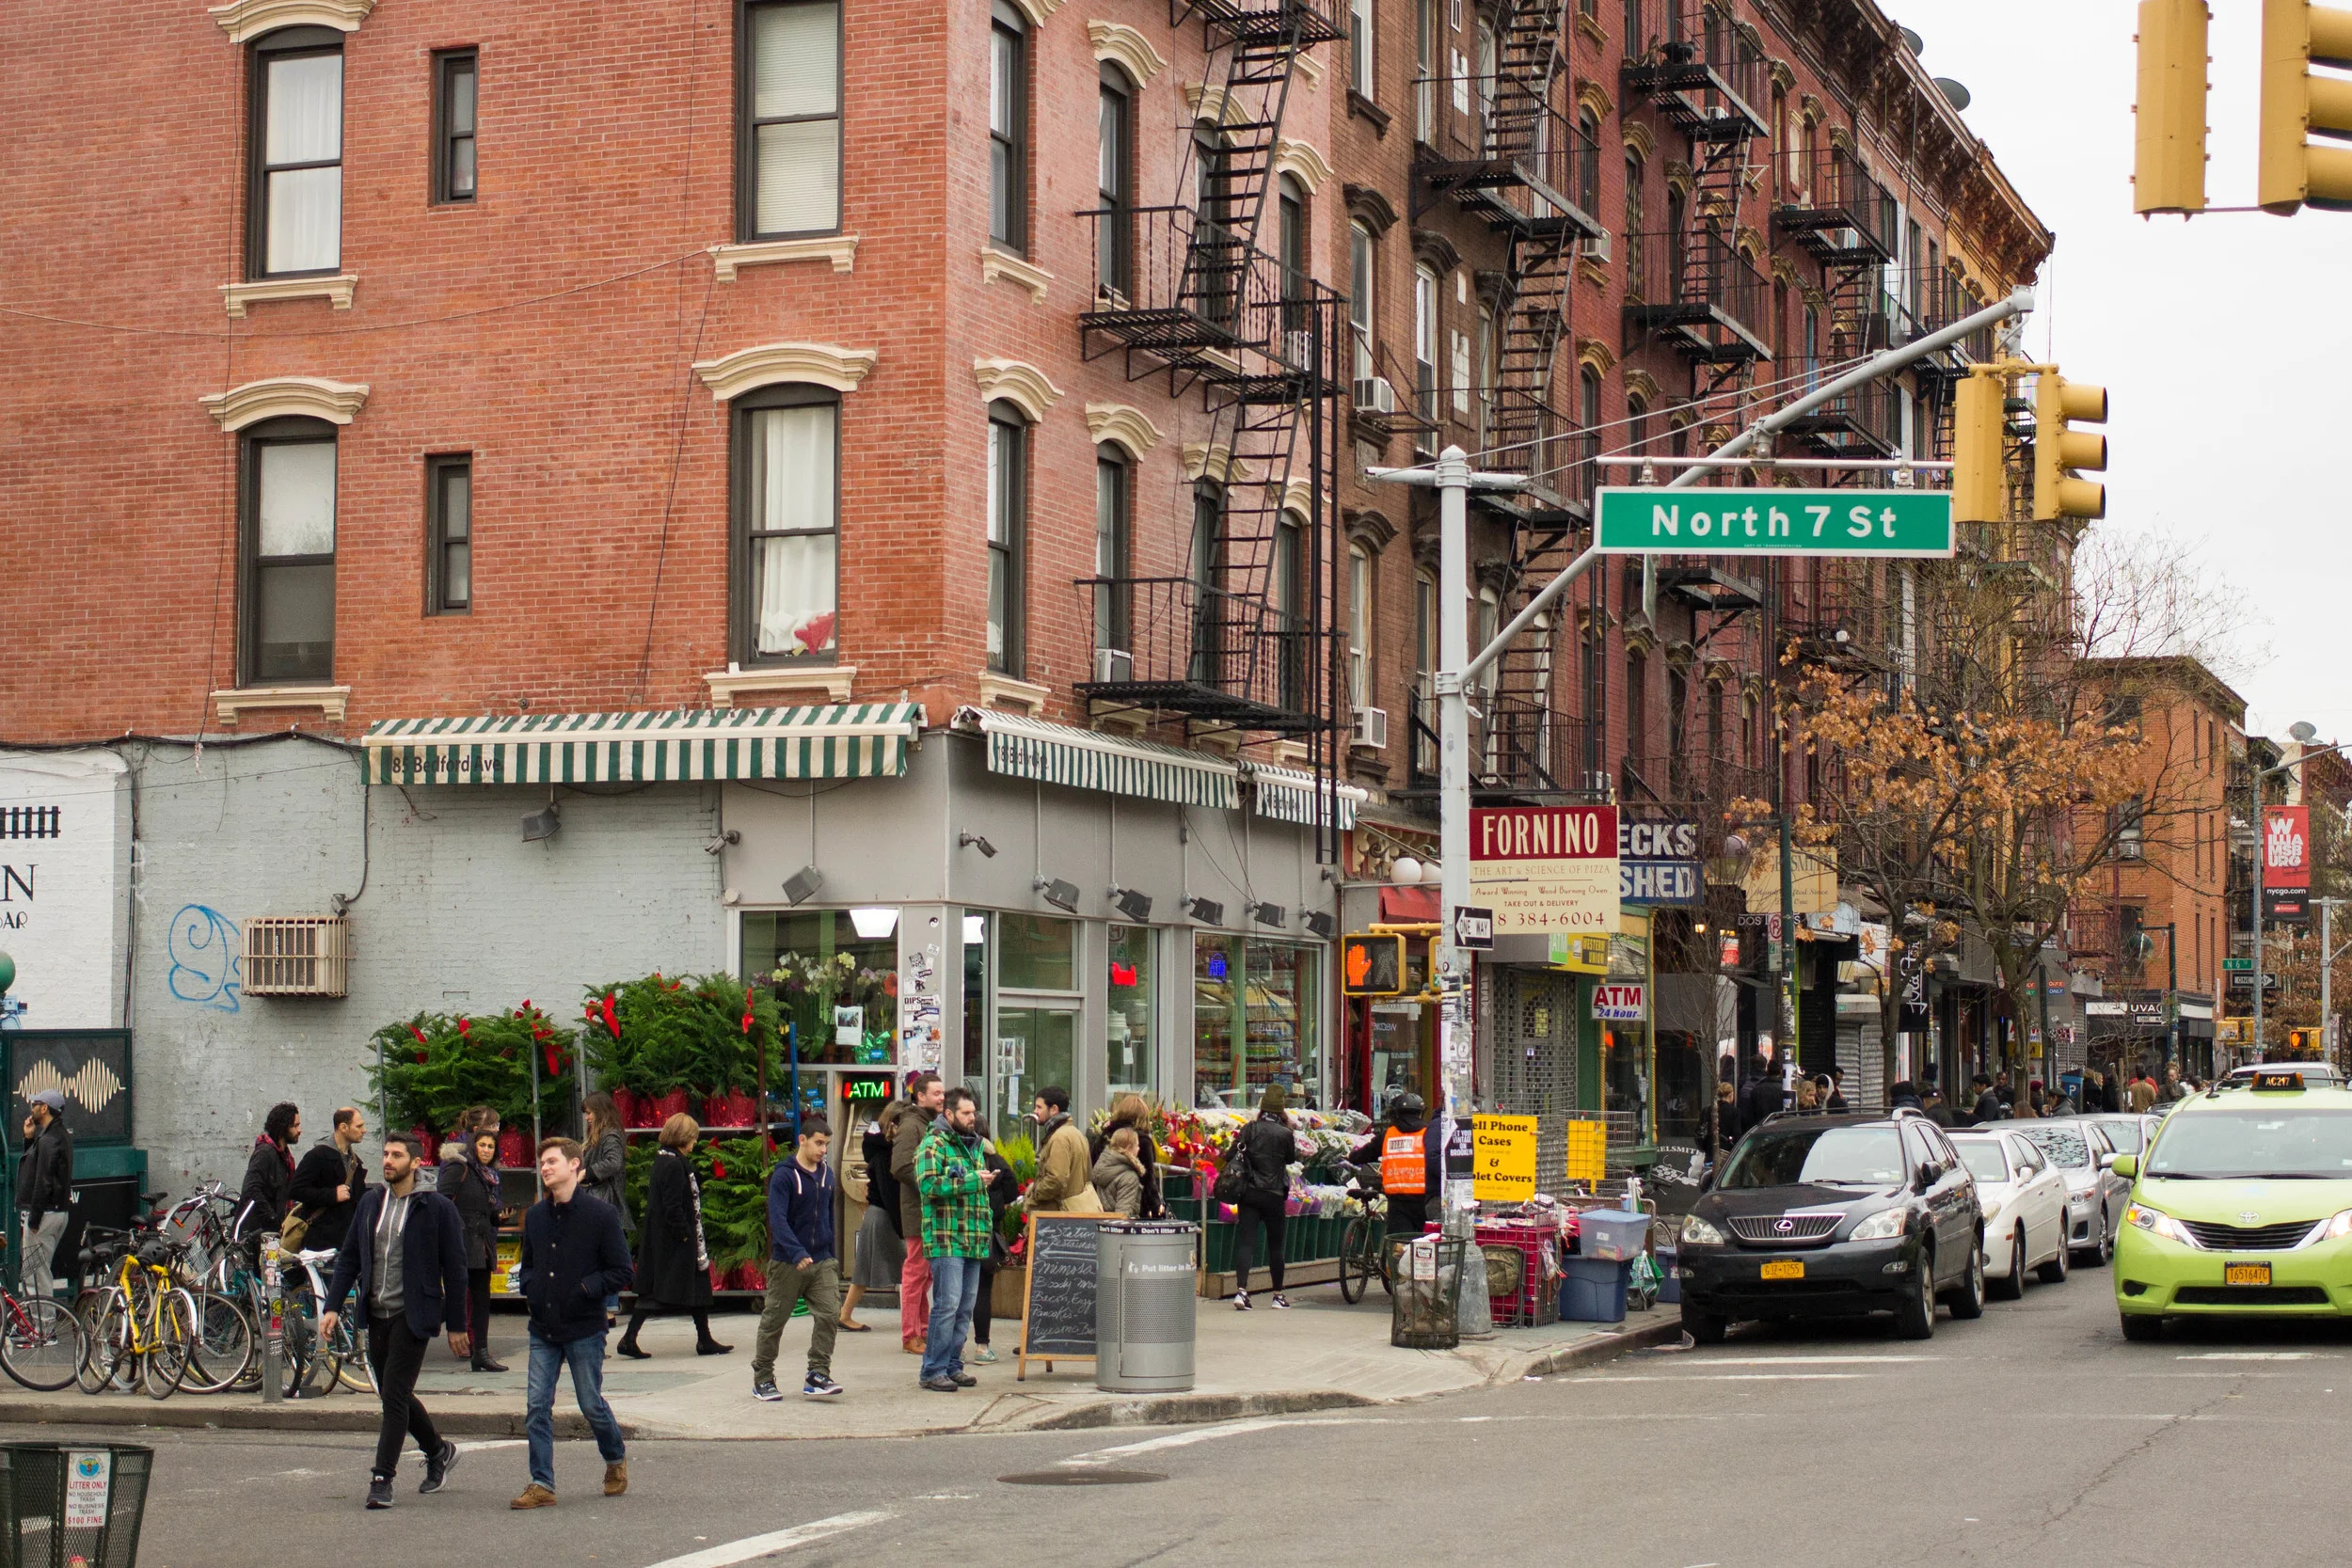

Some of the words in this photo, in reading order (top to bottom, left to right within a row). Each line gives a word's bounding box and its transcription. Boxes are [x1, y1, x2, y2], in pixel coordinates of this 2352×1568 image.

[1652, 504, 1789, 537] North
[1804, 506, 1831, 537] 7
[1847, 505, 1897, 538] St
[414, 754, 469, 772] Bedford
[1483, 813, 1598, 856] FORNINO
[1473, 866, 1491, 876] THE
[1495, 866, 1513, 875] ART
[1525, 865, 1565, 875] SCIENCE
[1568, 865, 1581, 874] OF
[1584, 864, 1610, 874] PIZZA
[1475, 887, 1499, 895] Award
[1501, 886, 1528, 896] Winning
[1537, 885, 1557, 895] Wood
[1559, 886, 1586, 895] Burning
[2266, 888, 2307, 896] nycgo.com
[1517, 911, 1604, 927] 384-6004
[1459, 918, 1471, 935] ONE
[1475, 919, 1488, 937] WAY
[1594, 987, 1641, 1006] ATM
[1597, 1007, 1612, 1018] 24
[1613, 1009, 1638, 1018] Hour
[2131, 1004, 2156, 1012] UVA
[2265, 1077, 2290, 1086] AC217
[849, 1081, 884, 1098] ATM
[2070, 1085, 2076, 1096] P
[1490, 1121, 1528, 1132] Phone
[1478, 1135, 1512, 1146] Cases
[1489, 1158, 1500, 1167] &
[1494, 1172, 1533, 1182] Covers
[1053, 1224, 1096, 1239] Station
[1141, 1264, 1157, 1273] Put
[1158, 1263, 1177, 1273] litter
[2230, 1268, 2267, 1280] T651647C
[70, 1481, 90, 1489] LITTER
[91, 1481, 107, 1489] ONLY
[87, 1515, 103, 1524] FINE
